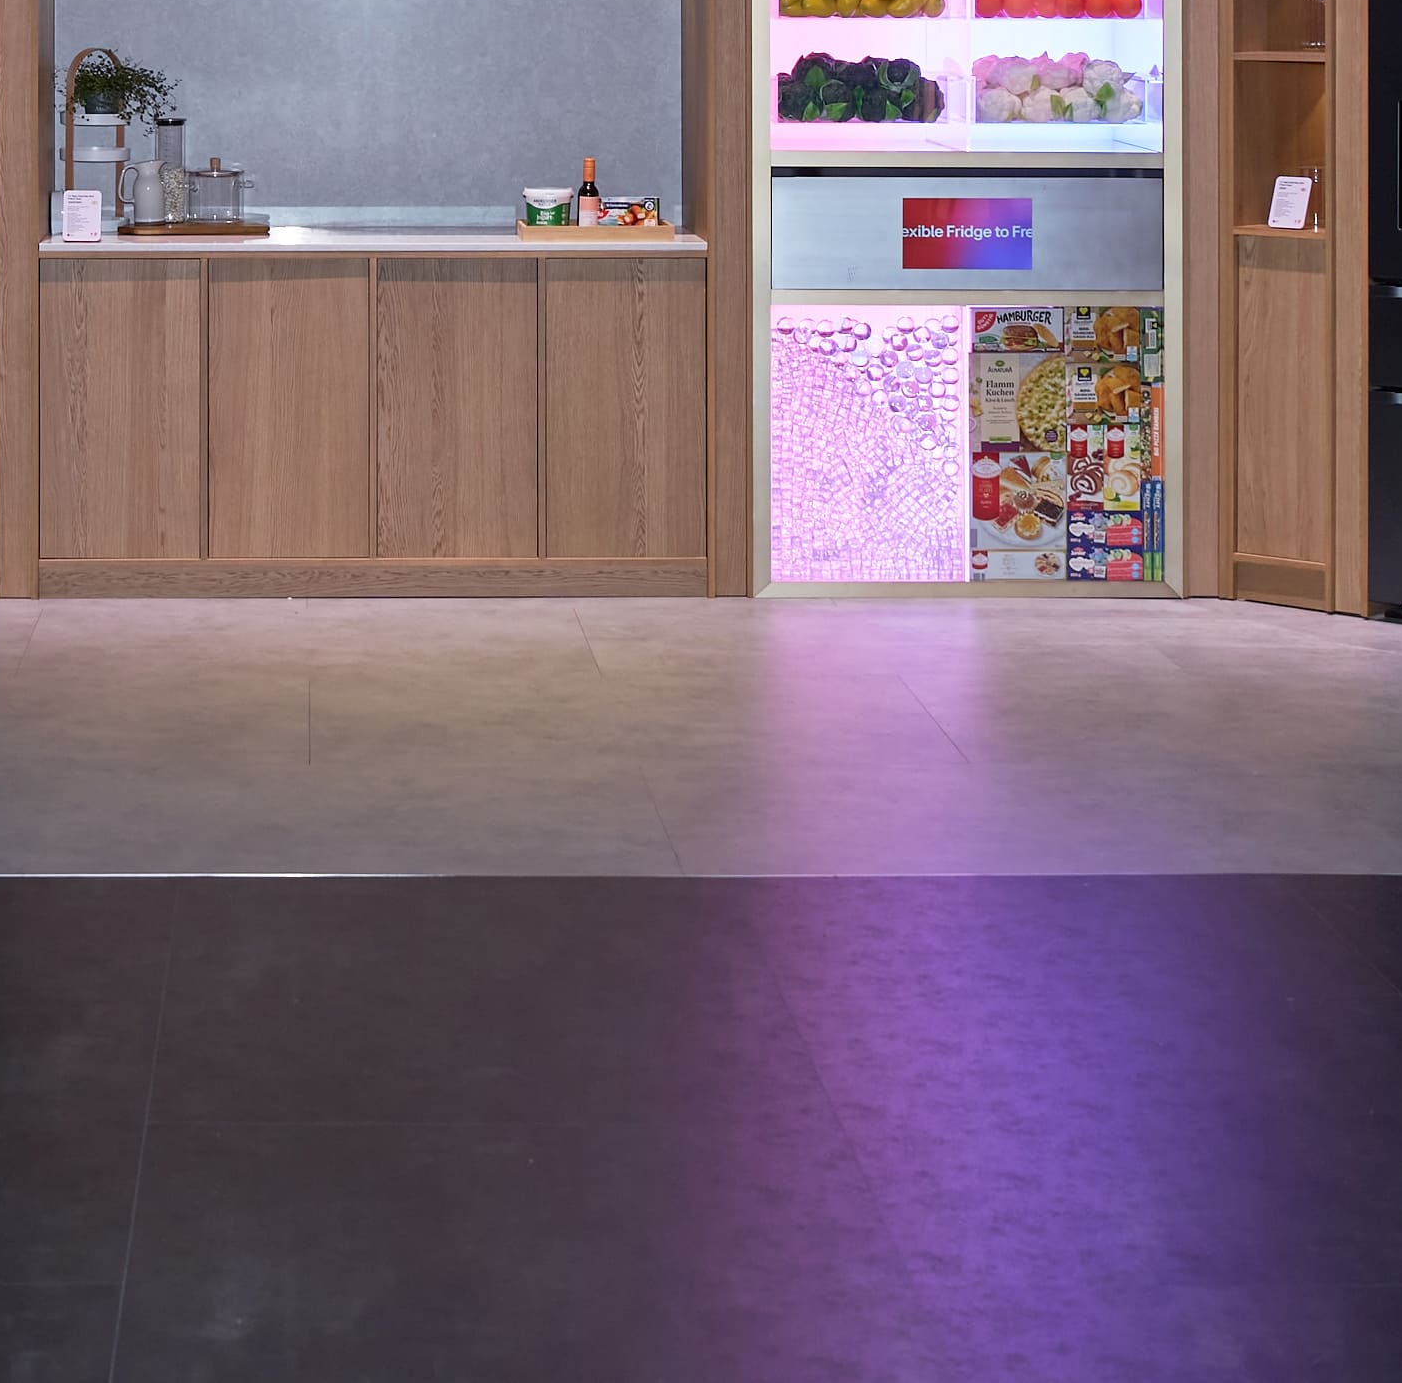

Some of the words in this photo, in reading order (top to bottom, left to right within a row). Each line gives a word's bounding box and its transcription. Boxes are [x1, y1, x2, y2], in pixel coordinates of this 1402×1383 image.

[946, 224, 993, 241] Fridge
[995, 226, 1010, 238] to
[996, 309, 1052, 325] HAMBURGER
[985, 380, 1015, 388] Flamm
[985, 388, 1015, 397] Kuchen
